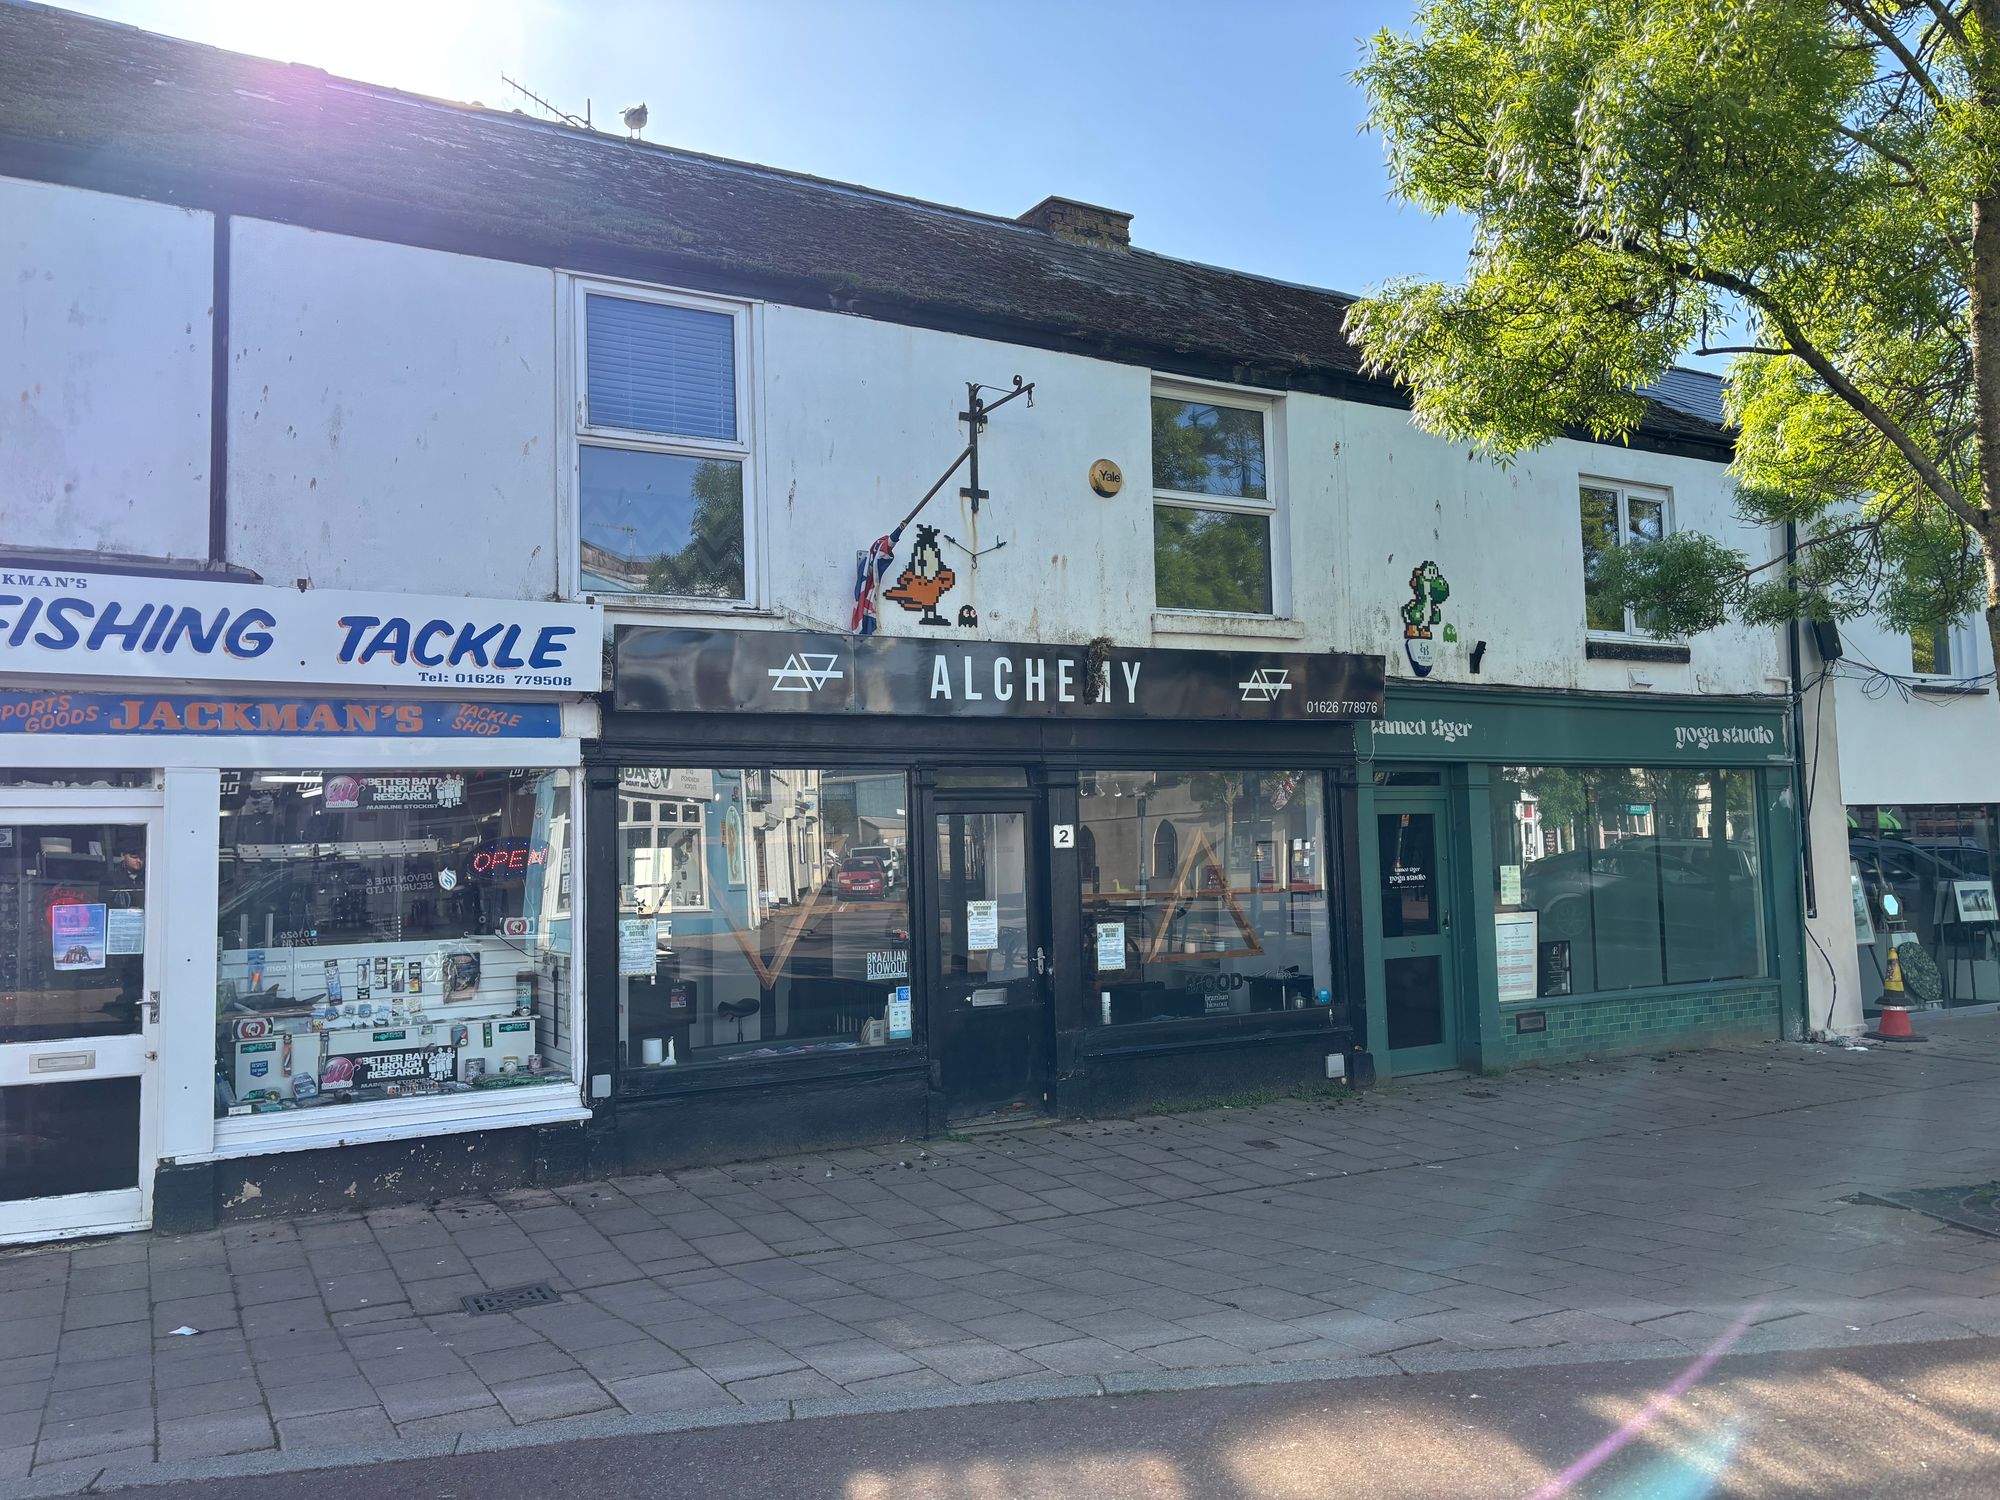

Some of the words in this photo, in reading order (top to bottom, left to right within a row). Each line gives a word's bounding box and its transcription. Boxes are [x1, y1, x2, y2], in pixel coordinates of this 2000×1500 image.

[1099, 469, 1121, 483] Yale
[337, 615, 577, 671] TACKLE
[418, 672, 449, 683] Tel:
[455, 673, 506, 685] 01626
[515, 675, 573, 687] 779508
[0, 694, 73, 721] PORTS
[1306, 700, 1339, 714] 01626
[1341, 701, 1378, 714] 778976
[24, 705, 100, 732] GOODS
[110, 700, 423, 733] JACKMAN'S
[458, 703, 522, 727] TACKLE
[451, 717, 501, 736] SHOP
[1431, 718, 1472, 743] tiger
[1674, 726, 1721, 750] yoga
[1722, 725, 1774, 744] studio
[367, 777, 411, 786] BETTER
[411, 777, 438, 785] BAIT
[375, 785, 430, 793] THROUGH
[372, 792, 432, 801] RESEARCH
[1059, 829, 1069, 843] 2
[473, 848, 547, 872] OPEN
[866, 950, 907, 964] BRAZILIAN
[867, 961, 908, 975] BLOWOUT
[362, 1054, 404, 1065] BETTER
[405, 1052, 430, 1061] BAIT
[367, 1067, 425, 1079] RESEARCH
[369, 1060, 422, 1072] THROUGH
